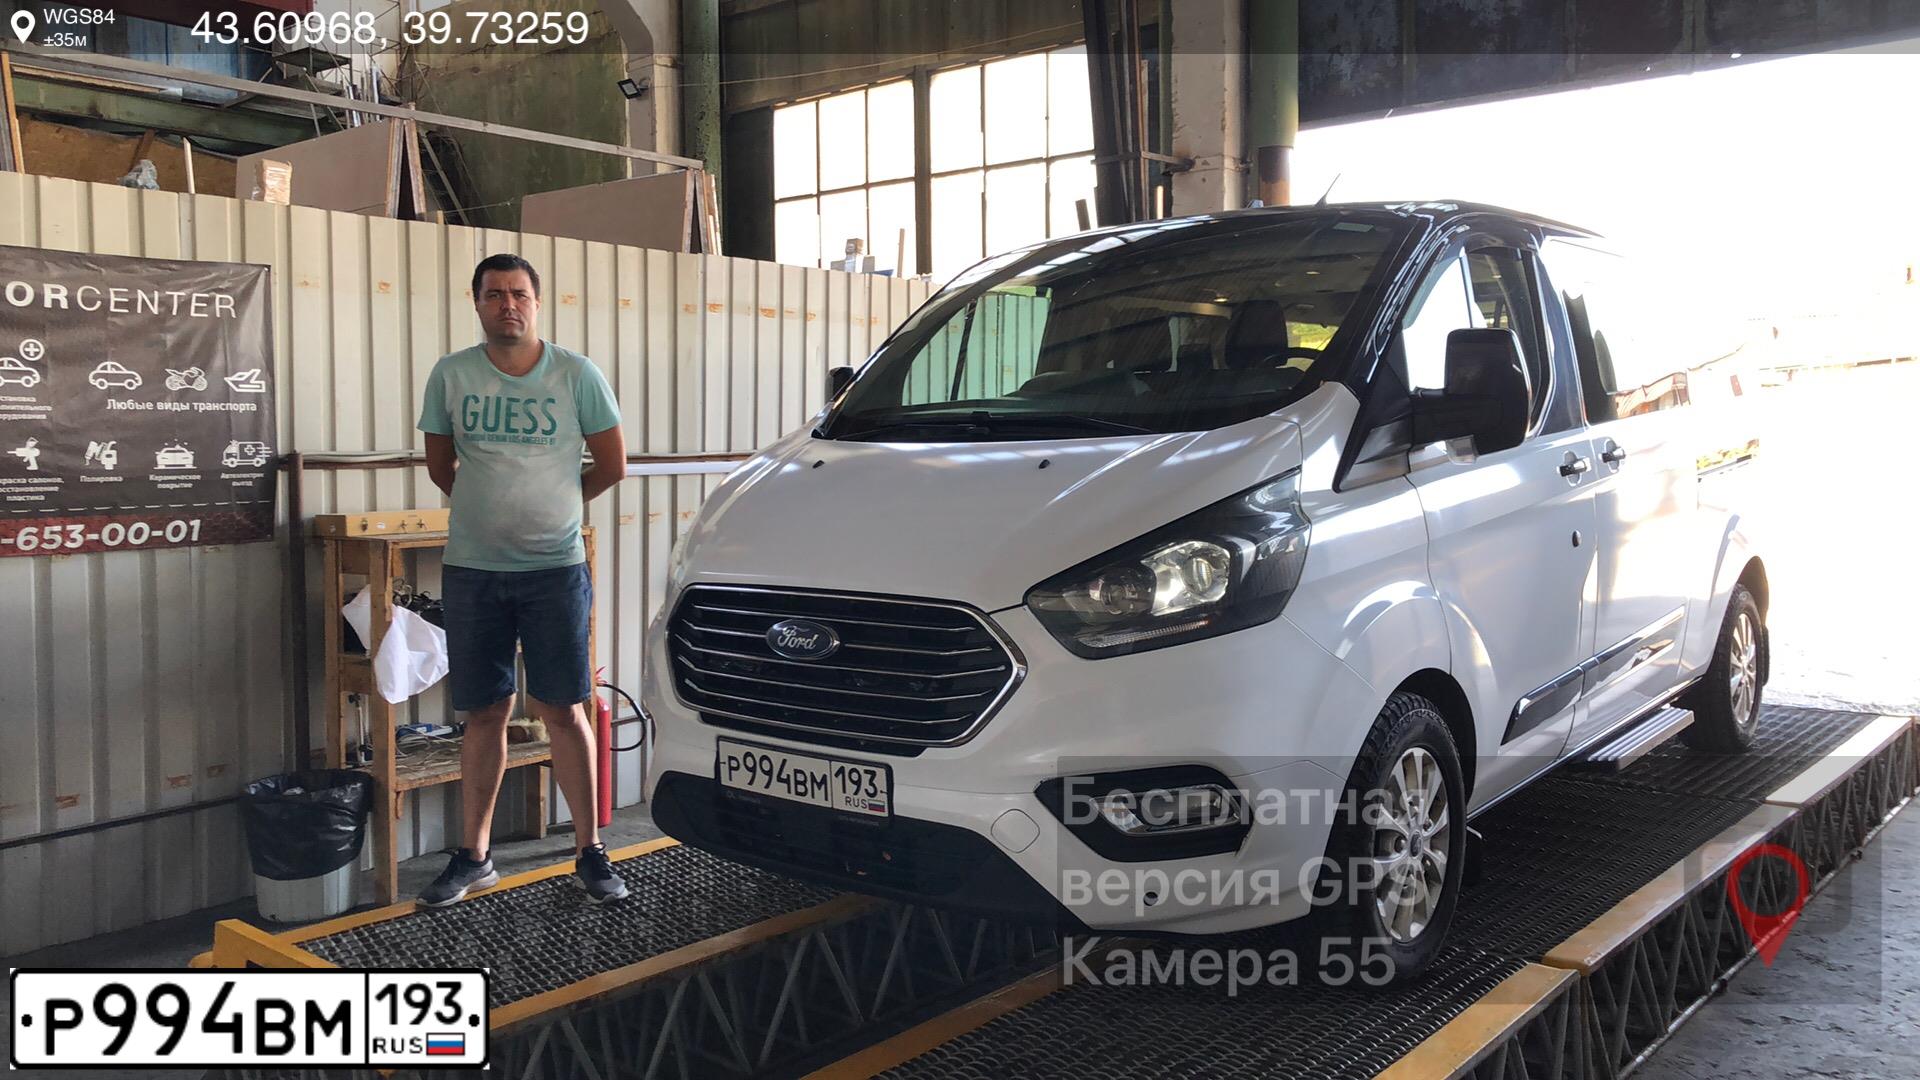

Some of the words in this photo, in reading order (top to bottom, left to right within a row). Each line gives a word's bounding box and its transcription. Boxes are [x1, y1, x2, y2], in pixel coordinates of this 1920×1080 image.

[106, 398, 154, 411] Любые
[156, 400, 190, 412] виды
[192, 401, 257, 413] транспорта
[461, 393, 557, 436] GUESS
[1, 519, 202, 551] -653-00-01
[777, 626, 820, 651] Ford
[834, 765, 878, 798] 193
[845, 796, 868, 809] RUS
